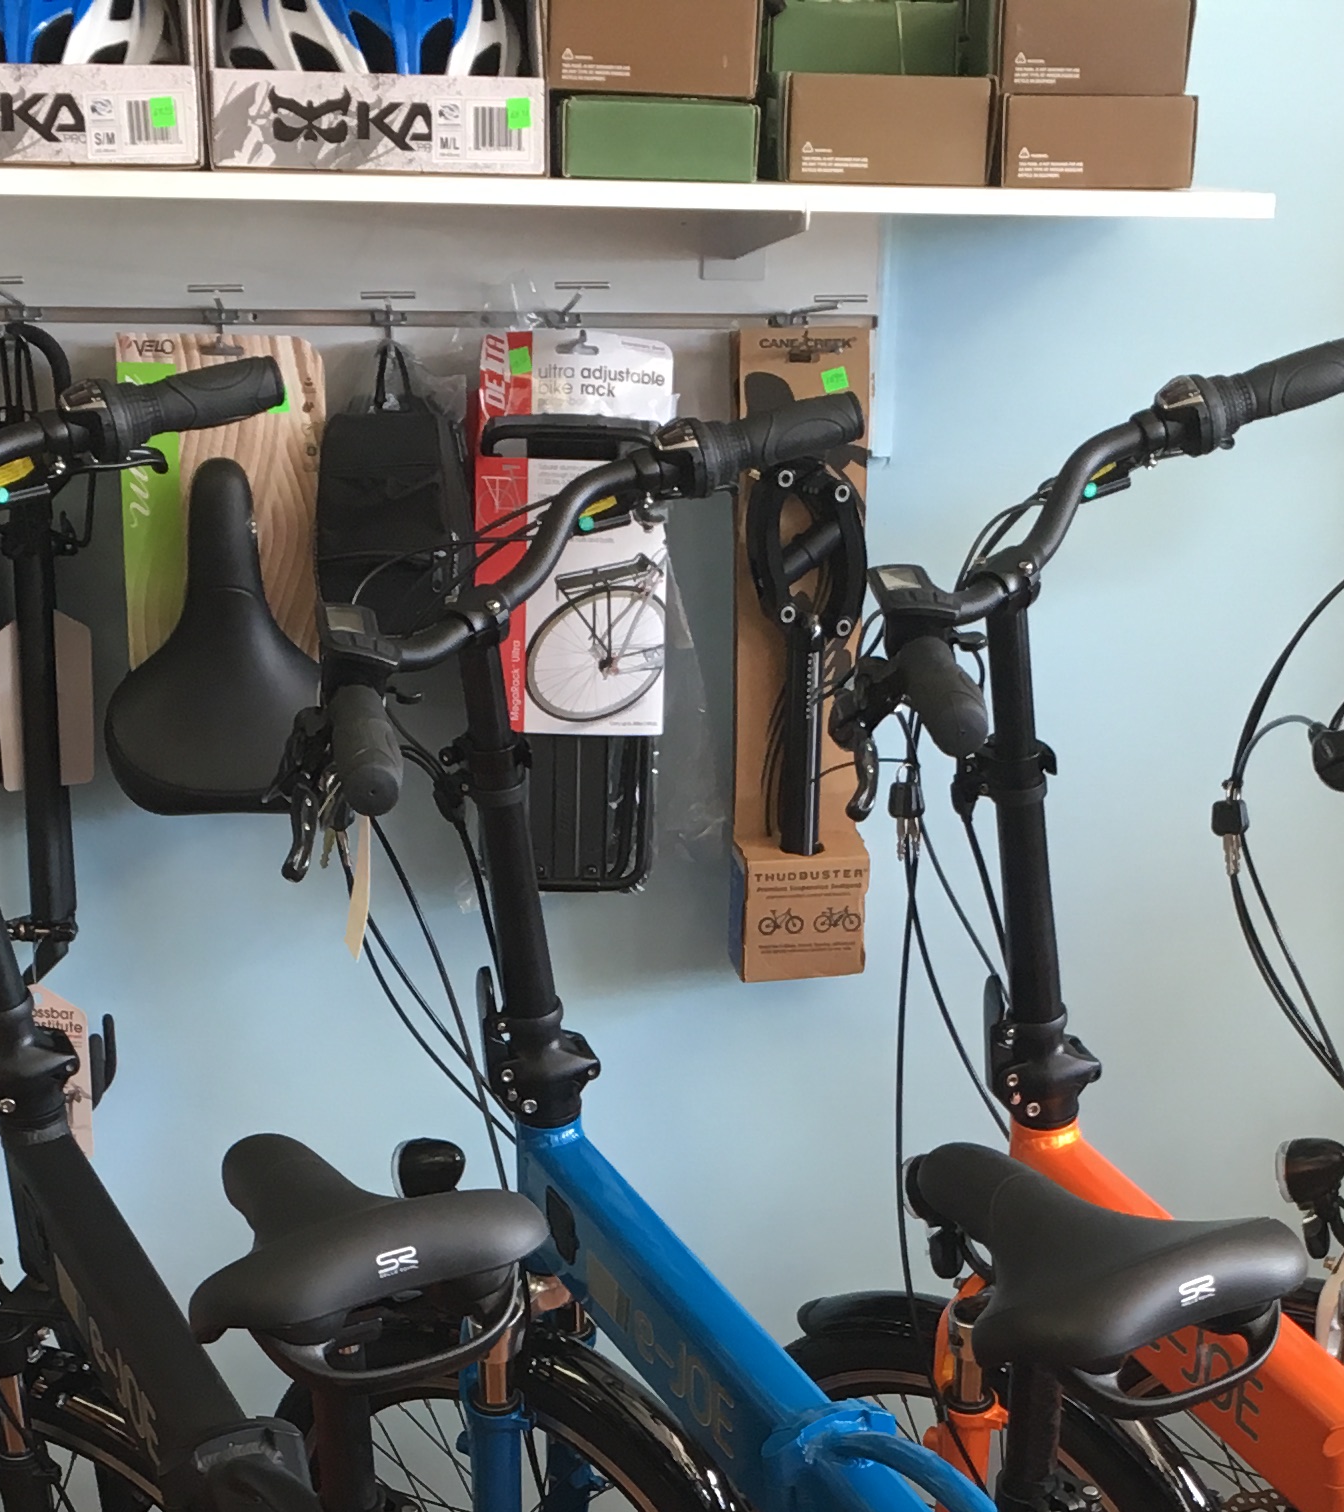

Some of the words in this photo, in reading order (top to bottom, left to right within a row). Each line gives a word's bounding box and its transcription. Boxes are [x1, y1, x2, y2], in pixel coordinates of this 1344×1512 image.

[0, 93, 86, 142] KA
[356, 101, 432, 151] KA
[94, 132, 116, 146] S/M
[439, 136, 460, 150] M/L
[133, 339, 175, 357] VELO
[759, 338, 799, 349] CANE
[485, 334, 506, 411] DELTA
[538, 364, 575, 379] ultra
[580, 366, 666, 387] adjustable
[538, 381, 573, 396] bike
[580, 382, 615, 398] rack
[755, 869, 864, 882] THUDBUSTER
[31, 1007, 75, 1021] ossbar
[34, 1018, 83, 1033] stitute
[633, 1305, 736, 1461] e-JOE
[1151, 1323, 1264, 1442] -JOE
